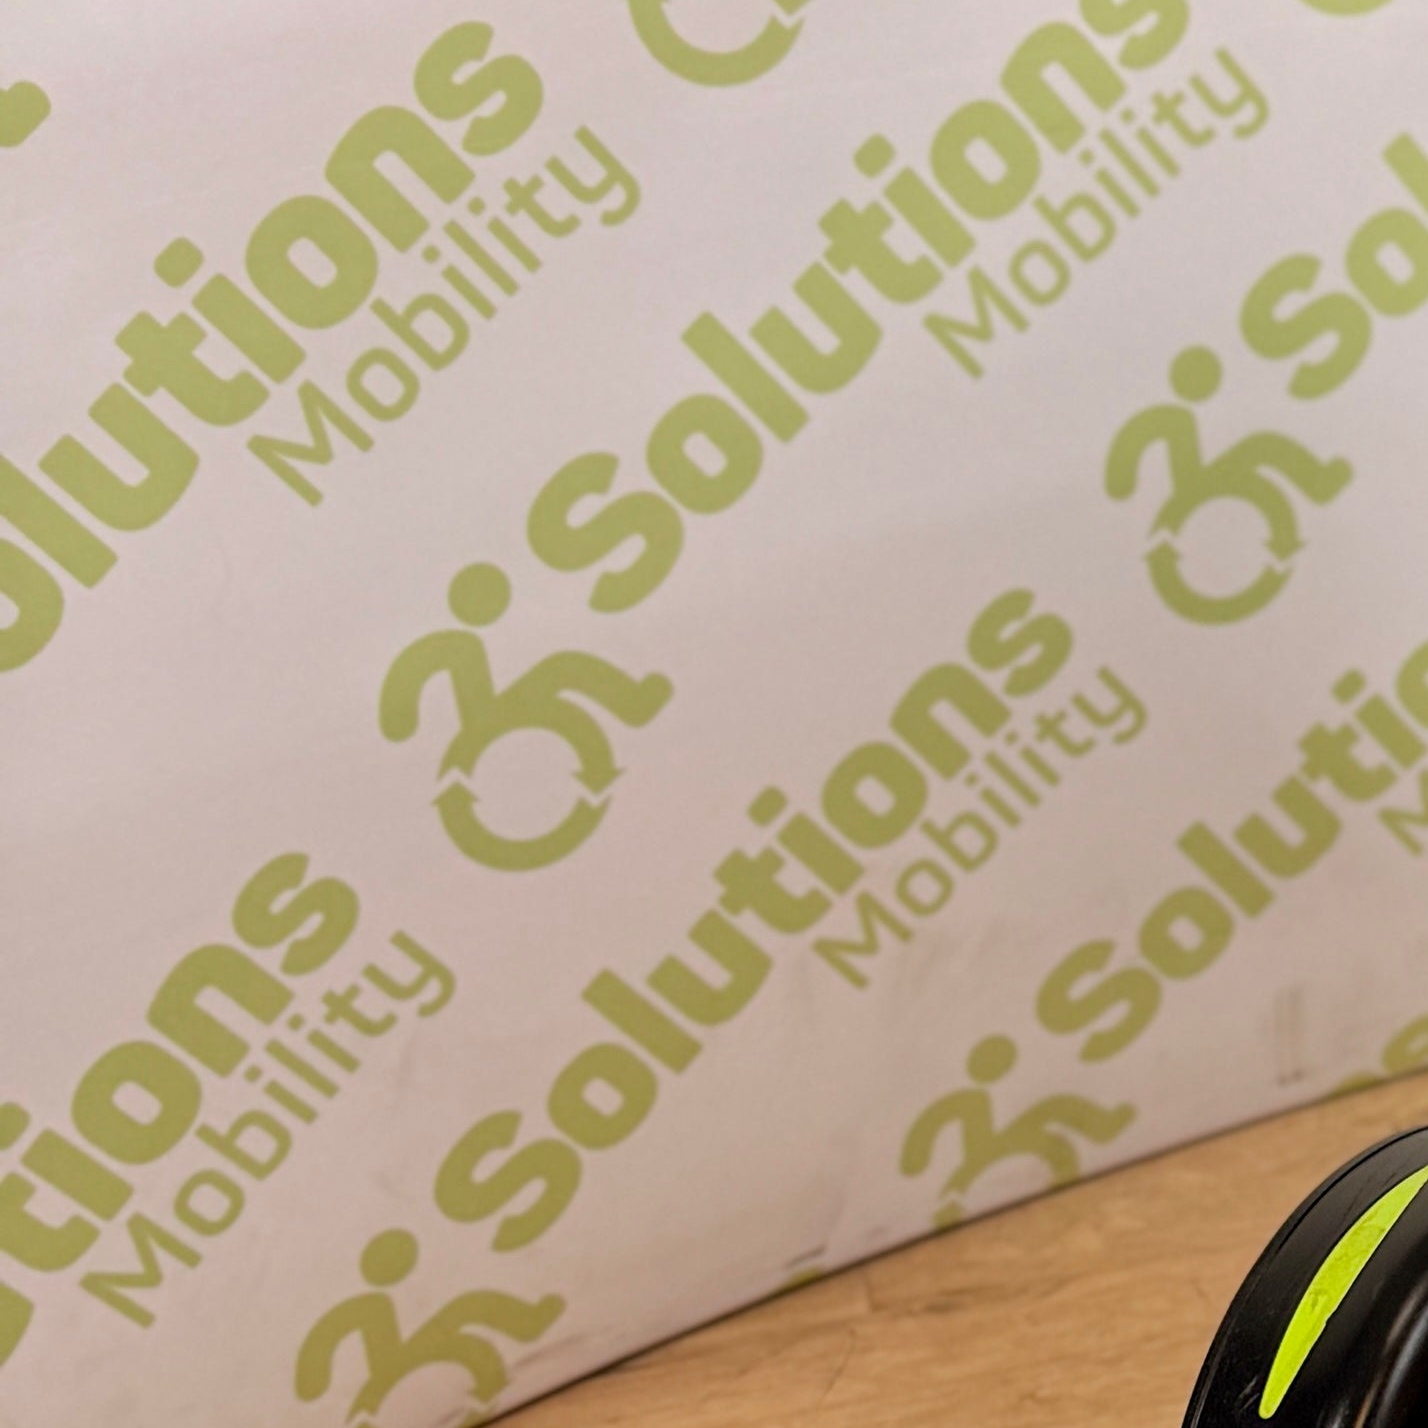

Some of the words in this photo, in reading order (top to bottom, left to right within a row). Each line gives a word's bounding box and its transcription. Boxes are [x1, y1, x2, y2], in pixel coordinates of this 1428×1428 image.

[247, 127, 640, 506] Mobility
[923, 48, 1269, 378] Mobility
[433, 589, 1073, 1253] Solutions
[813, 669, 1146, 987] Mobility
[0, 853, 358, 1364] tions
[81, 933, 454, 1327] Mobility
